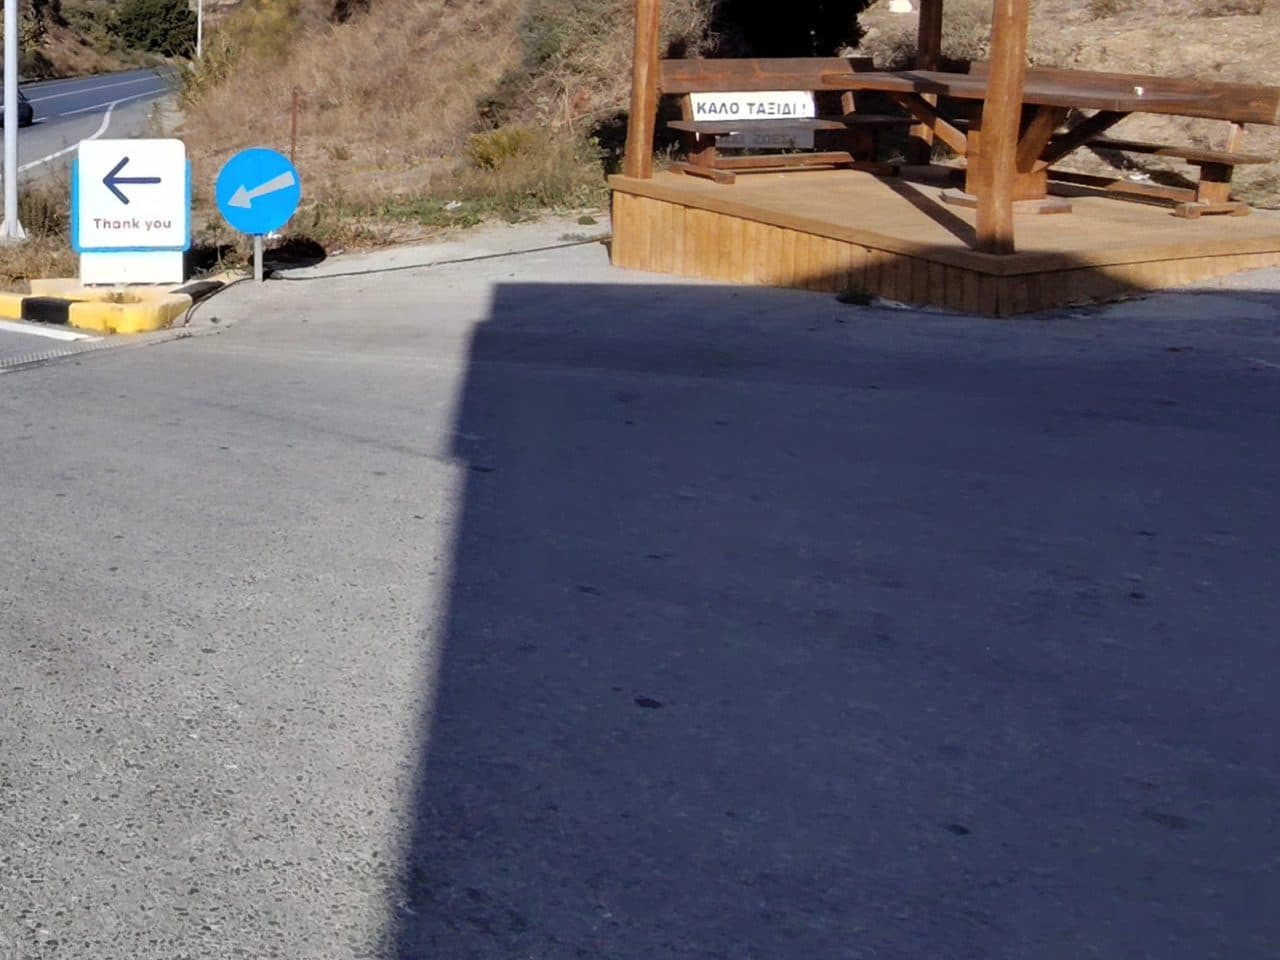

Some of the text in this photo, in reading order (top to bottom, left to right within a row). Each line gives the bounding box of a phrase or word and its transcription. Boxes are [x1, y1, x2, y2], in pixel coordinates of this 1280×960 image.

[697, 102, 740, 115] ΚΑΛΟ
[93, 217, 172, 232] Thank you
